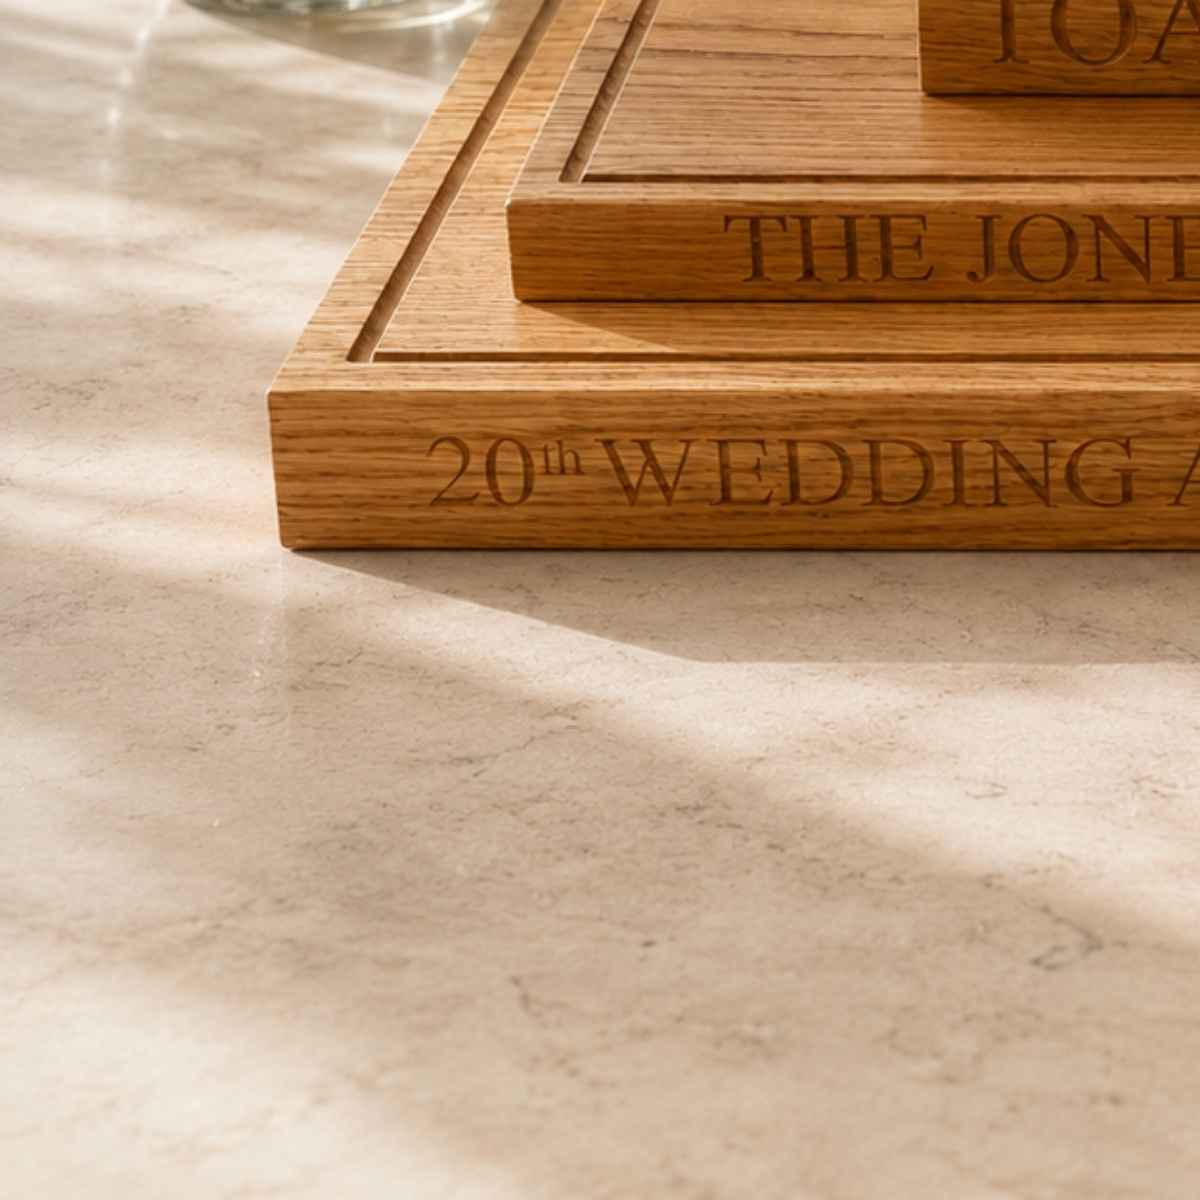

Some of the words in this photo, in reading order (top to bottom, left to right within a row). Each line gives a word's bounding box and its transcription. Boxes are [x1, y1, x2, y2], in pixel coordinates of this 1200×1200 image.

[723, 213, 934, 284] THE
[426, 435, 585, 507] 20th
[594, 436, 1140, 509] WEDDING
